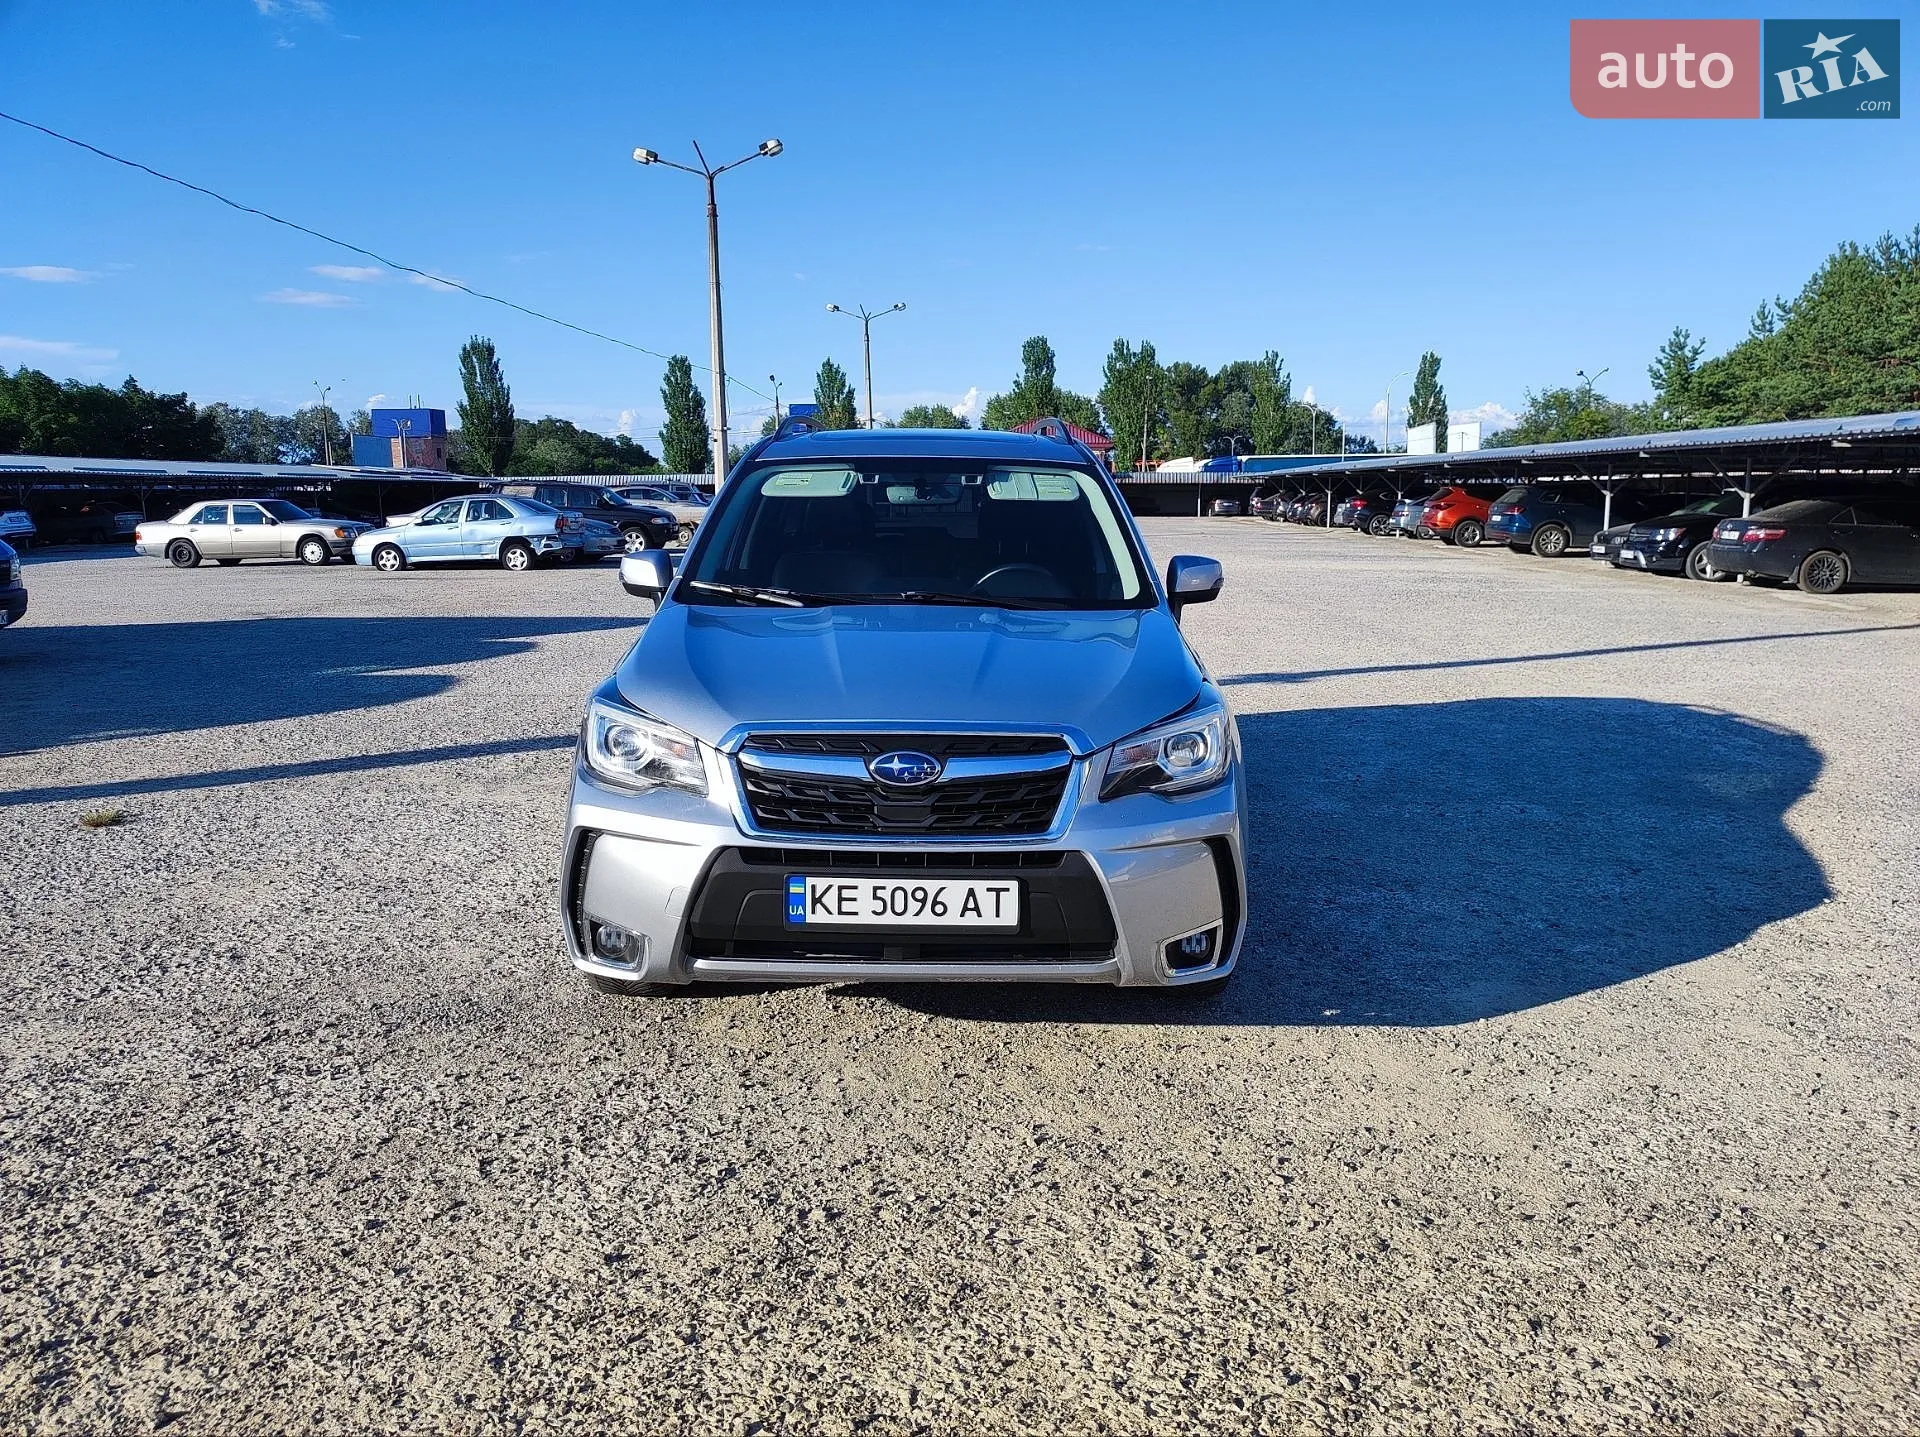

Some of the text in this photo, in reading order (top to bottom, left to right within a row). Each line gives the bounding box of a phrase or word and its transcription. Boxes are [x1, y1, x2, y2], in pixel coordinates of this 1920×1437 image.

[789, 905, 805, 916] UA
[810, 883, 1010, 918] KE 5096 AT
